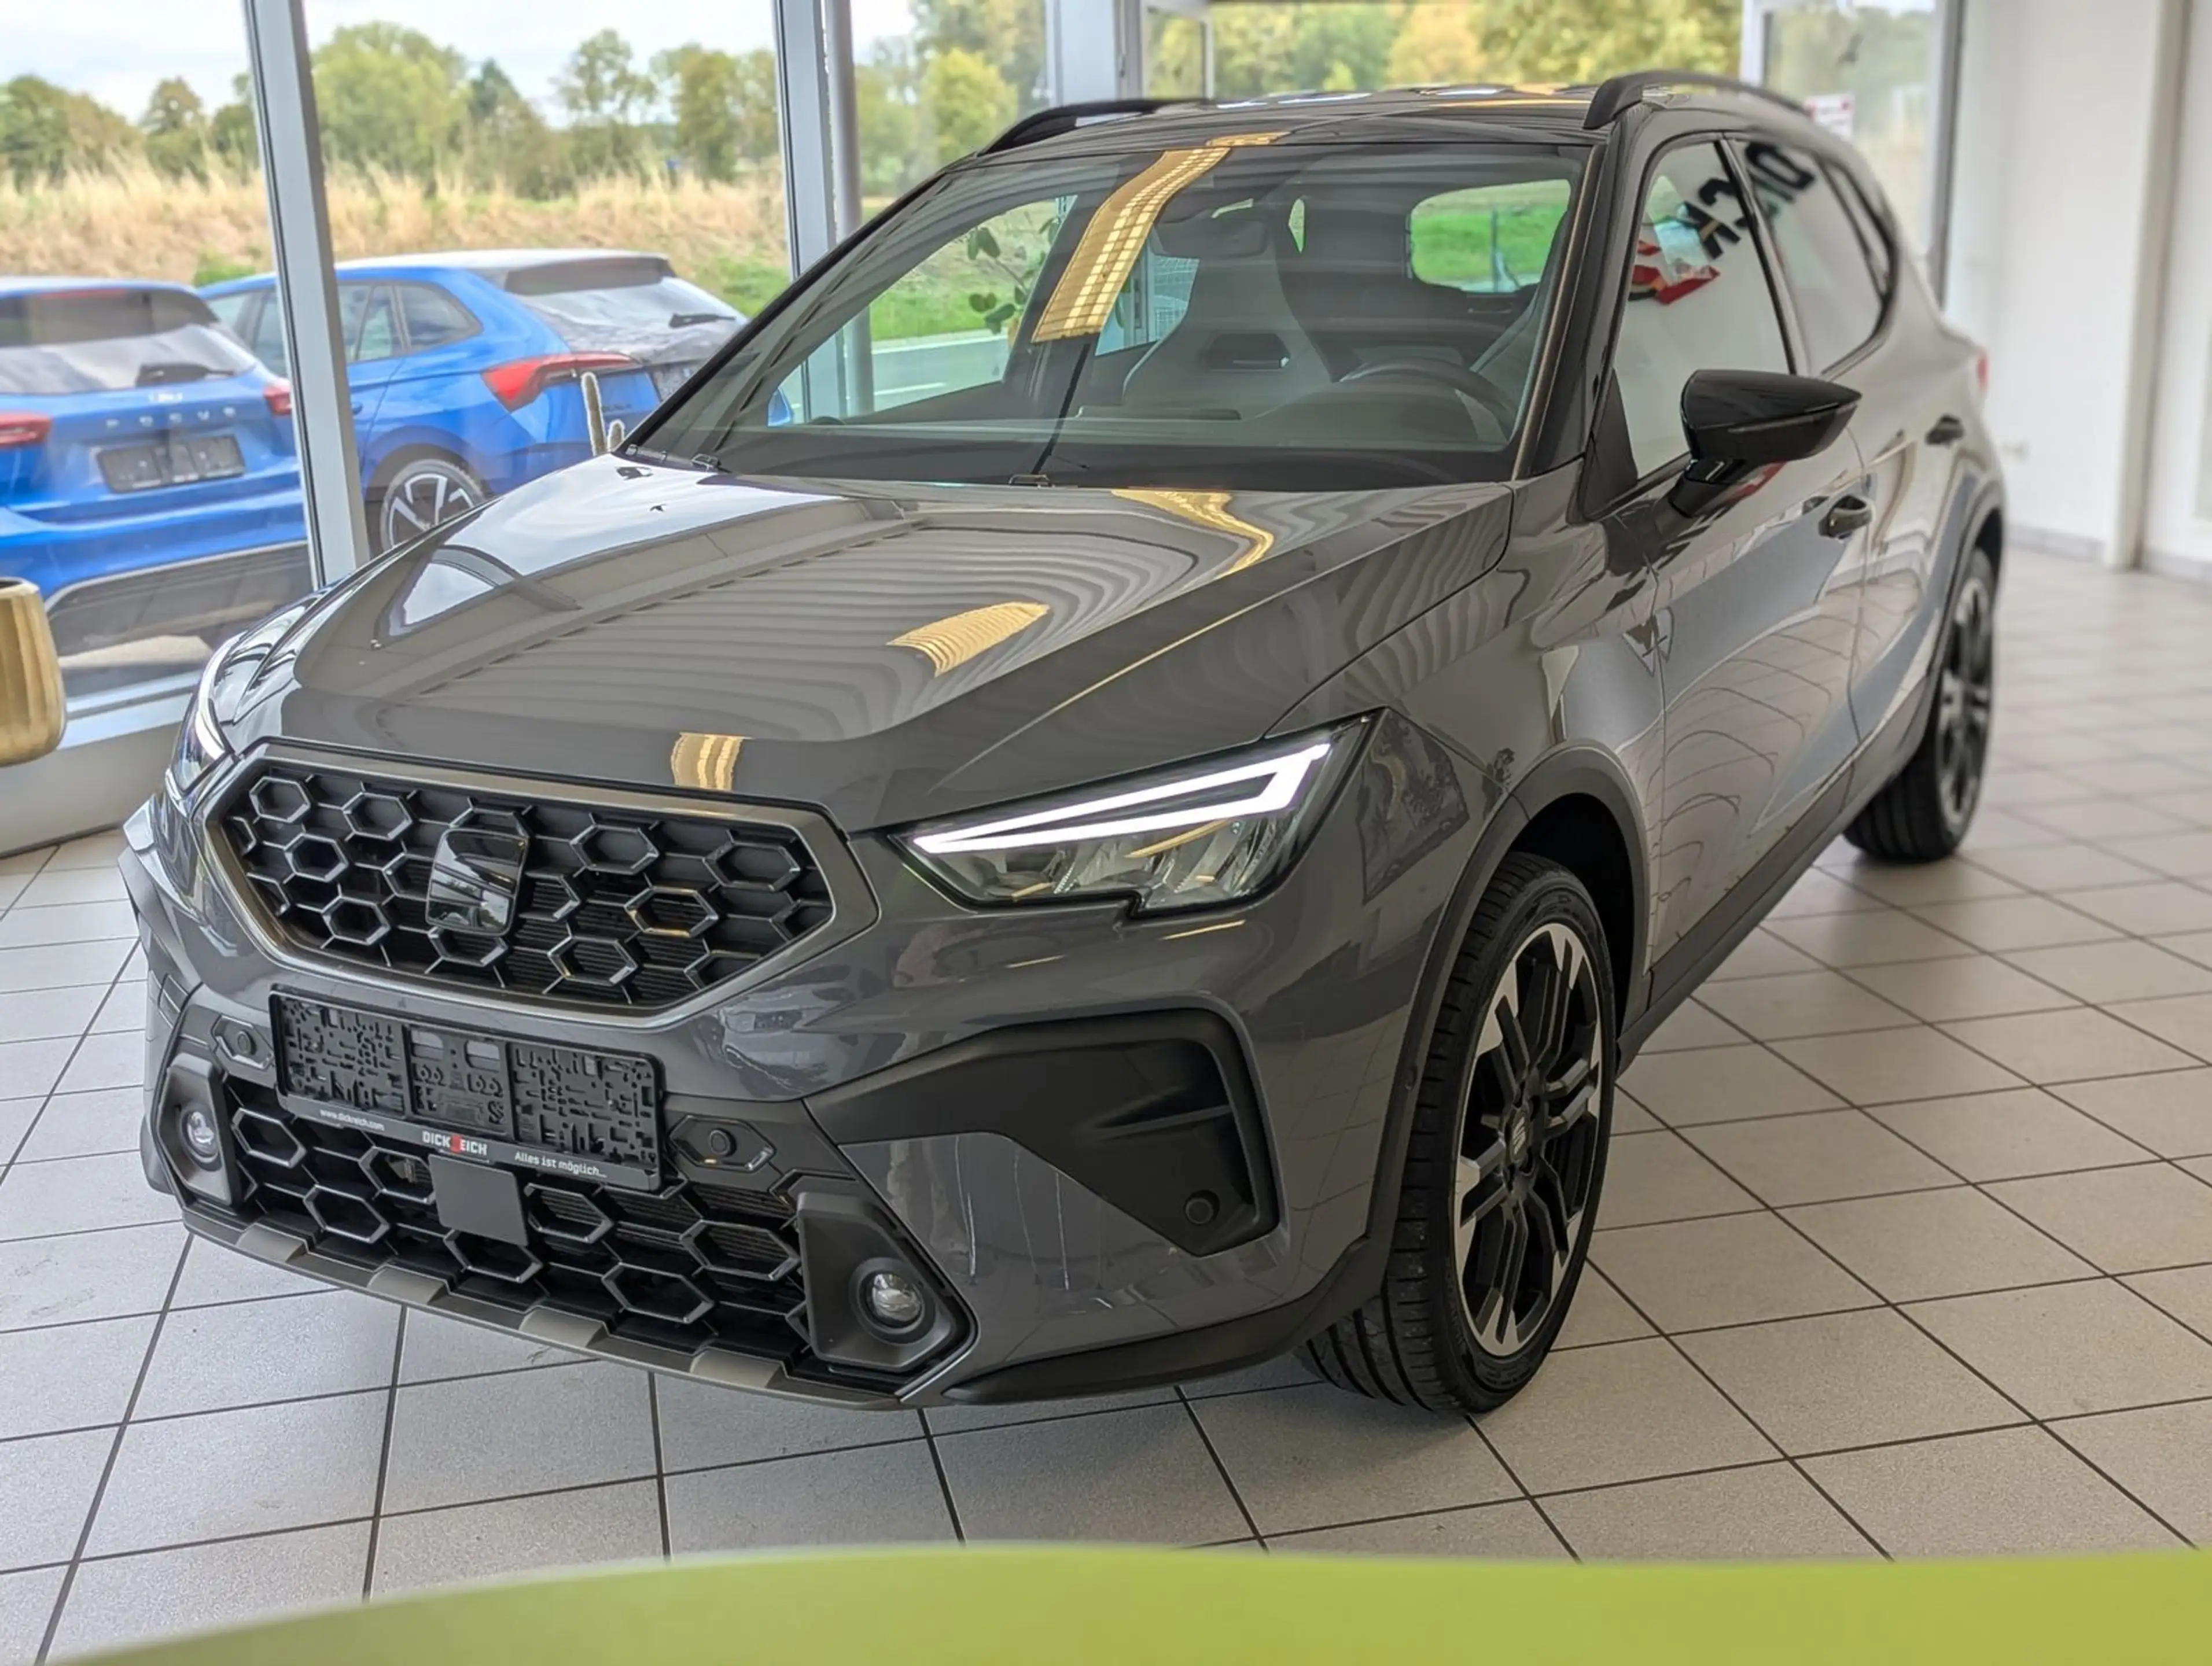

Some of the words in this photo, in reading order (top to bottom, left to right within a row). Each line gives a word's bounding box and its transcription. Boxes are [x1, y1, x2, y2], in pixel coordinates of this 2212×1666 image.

[422, 1130, 488, 1156] DICKEICH
[514, 1151, 539, 1165] Alles
[541, 1156, 557, 1169] ist
